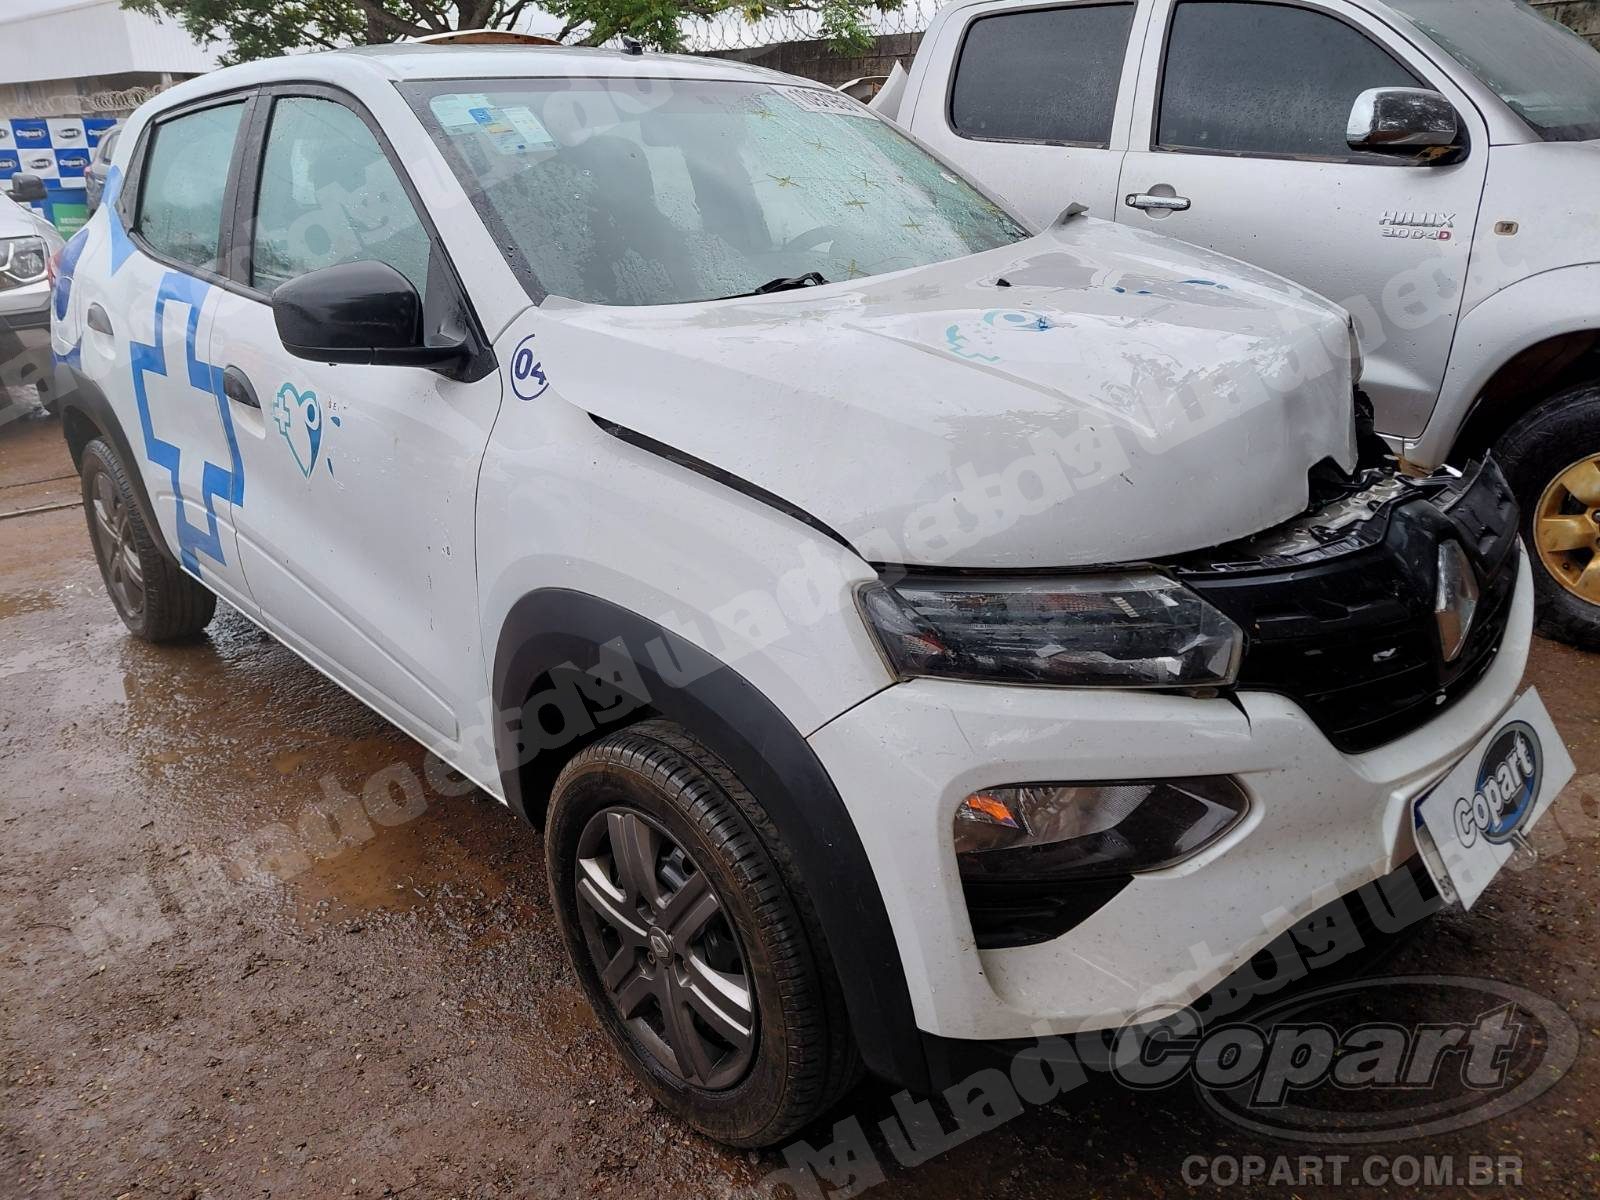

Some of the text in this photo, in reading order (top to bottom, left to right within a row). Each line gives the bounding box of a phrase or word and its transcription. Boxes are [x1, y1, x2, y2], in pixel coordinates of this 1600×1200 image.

[1379, 208, 1457, 228] HILUX
[514, 348, 547, 386] 04
[1453, 729, 1535, 849] Copart
